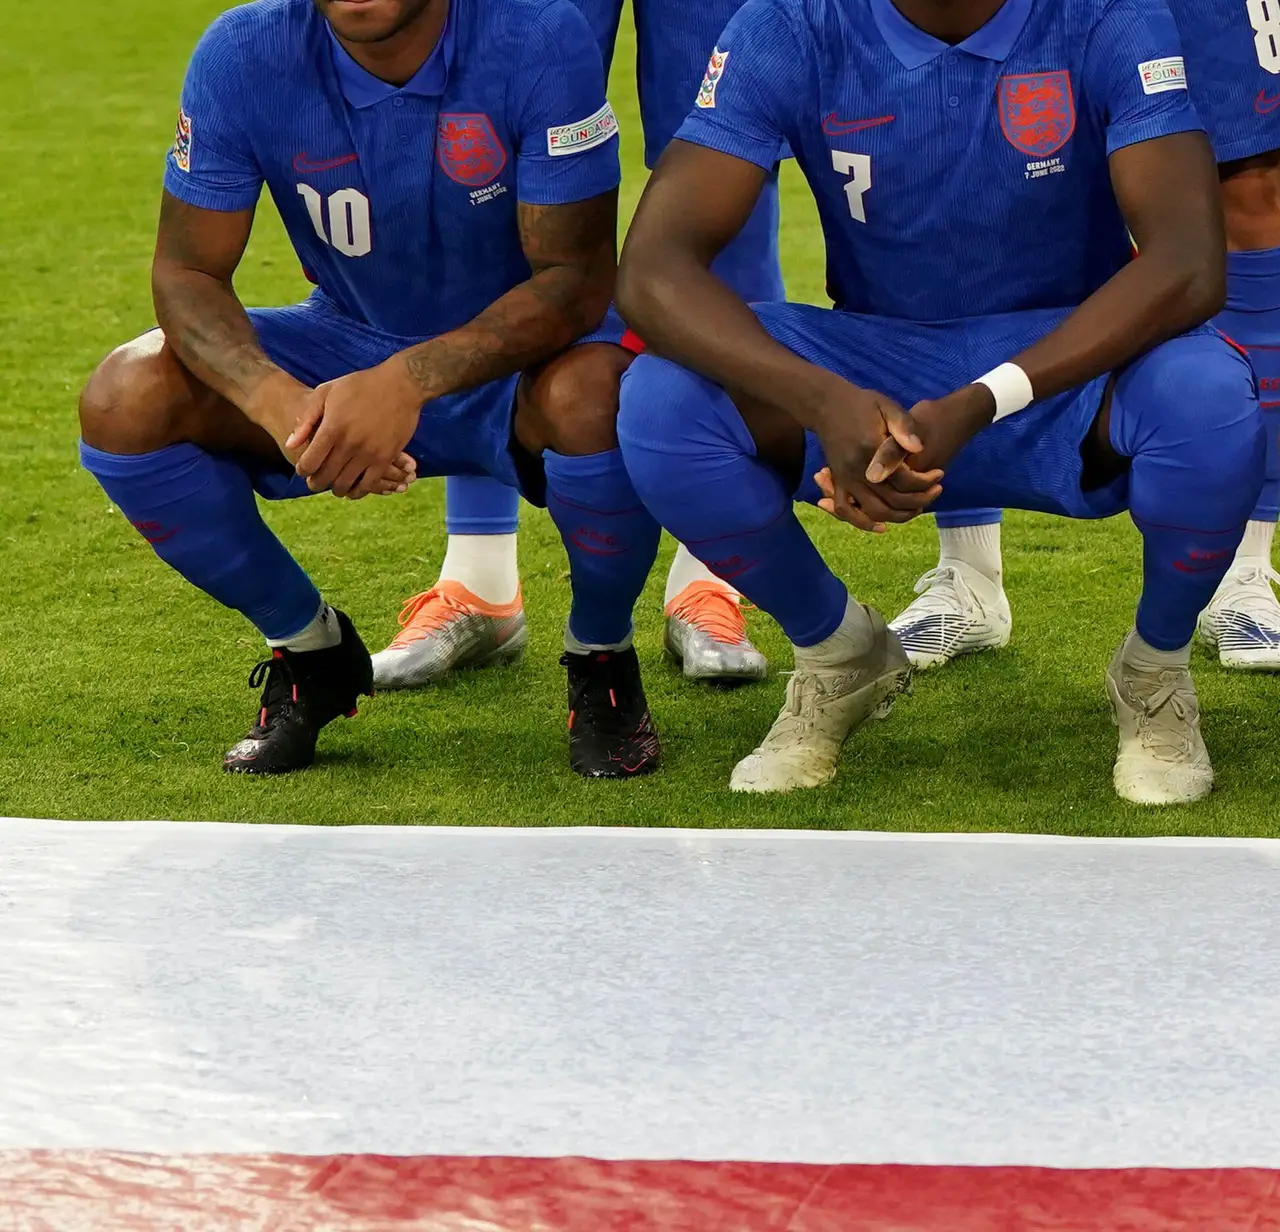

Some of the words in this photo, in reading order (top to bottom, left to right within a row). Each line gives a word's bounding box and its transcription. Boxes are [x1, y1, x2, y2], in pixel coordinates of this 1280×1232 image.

[1026, 157, 1061, 171] GERMANY
[1031, 168, 1048, 178] JUNE
[469, 182, 501, 198] GERMANY
[832, 150, 871, 223] 7
[297, 182, 372, 257] 10
